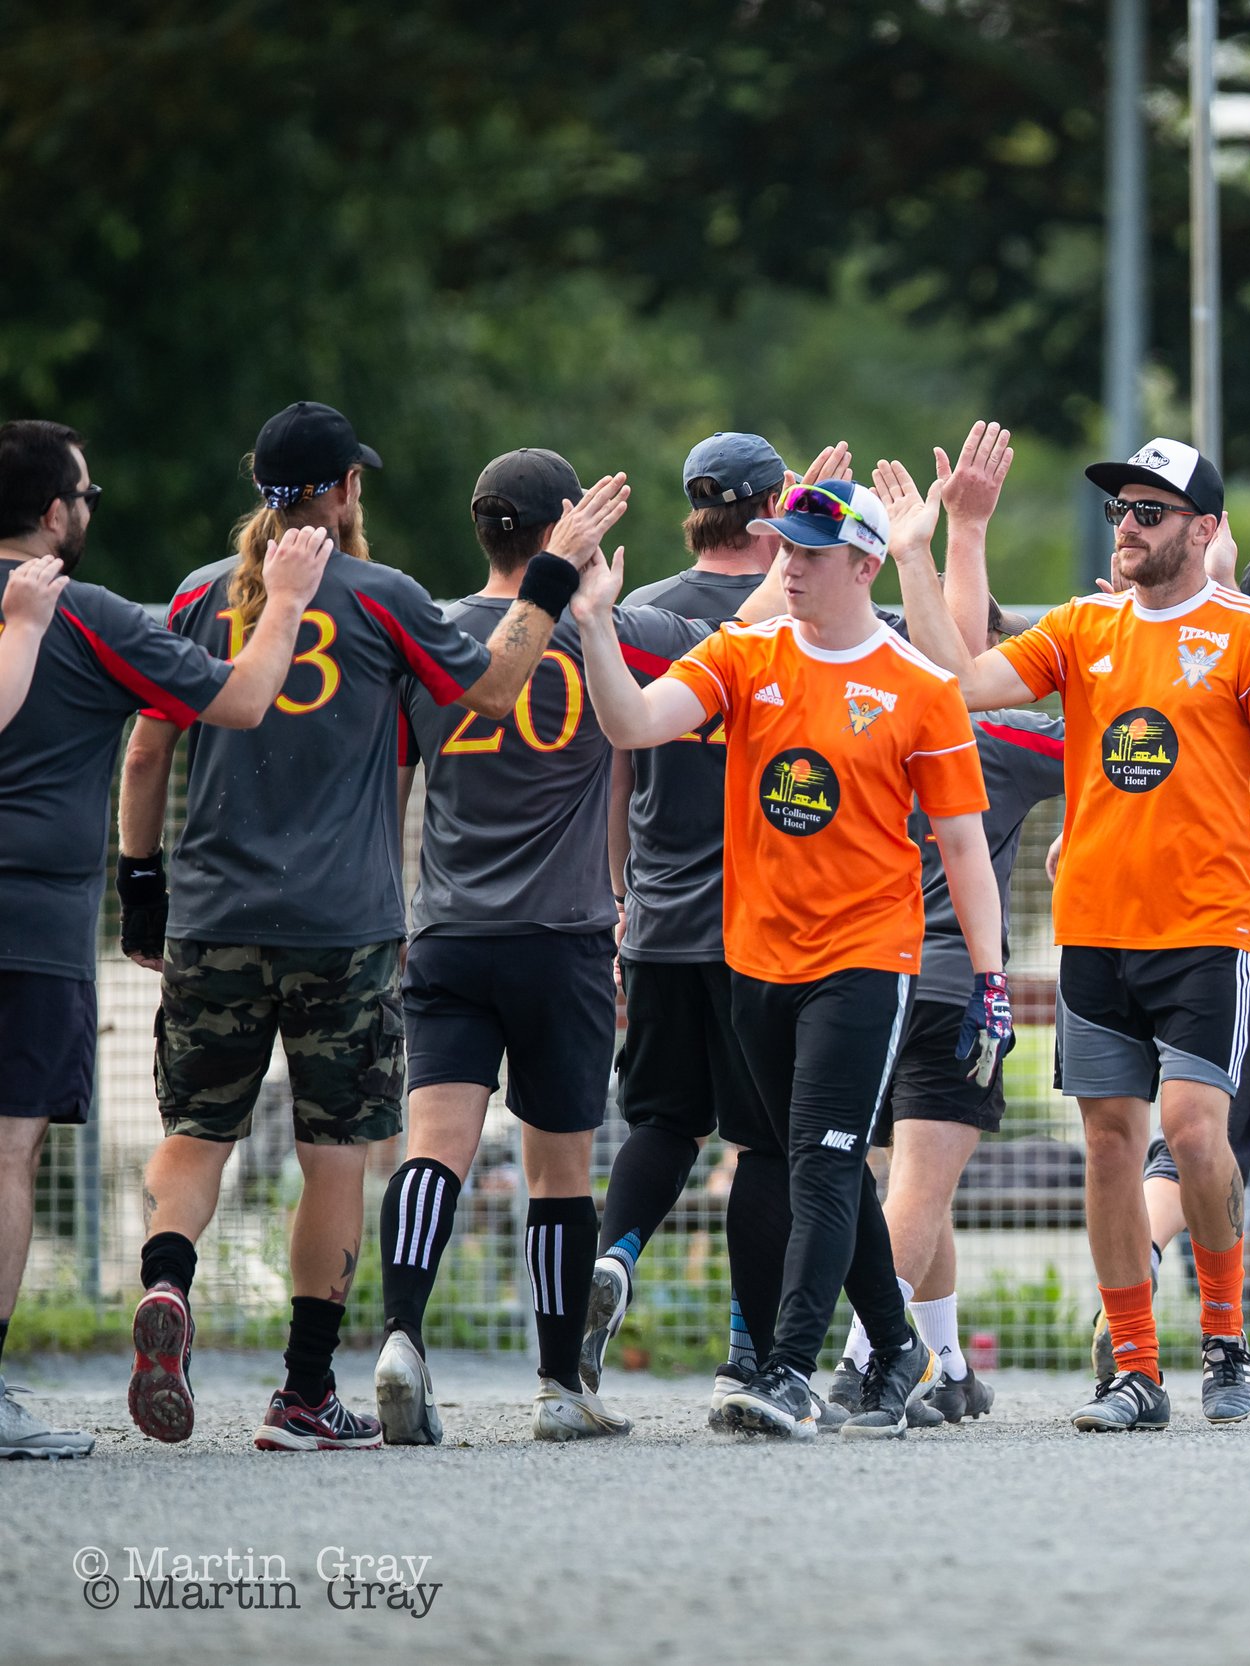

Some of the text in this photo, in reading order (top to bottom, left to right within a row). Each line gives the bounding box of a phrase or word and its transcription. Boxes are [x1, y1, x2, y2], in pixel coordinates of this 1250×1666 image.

[1178, 626, 1230, 650] TITANS
[754, 693, 784, 706] adidas
[844, 681, 898, 712] TITANS
[1112, 765, 1161, 776] La Collinette
[1125, 776, 1147, 786] Hotel
[770, 803, 821, 823] La Collinette
[783, 817, 806, 830] Hotel
[820, 1129, 858, 1152] NIKE
